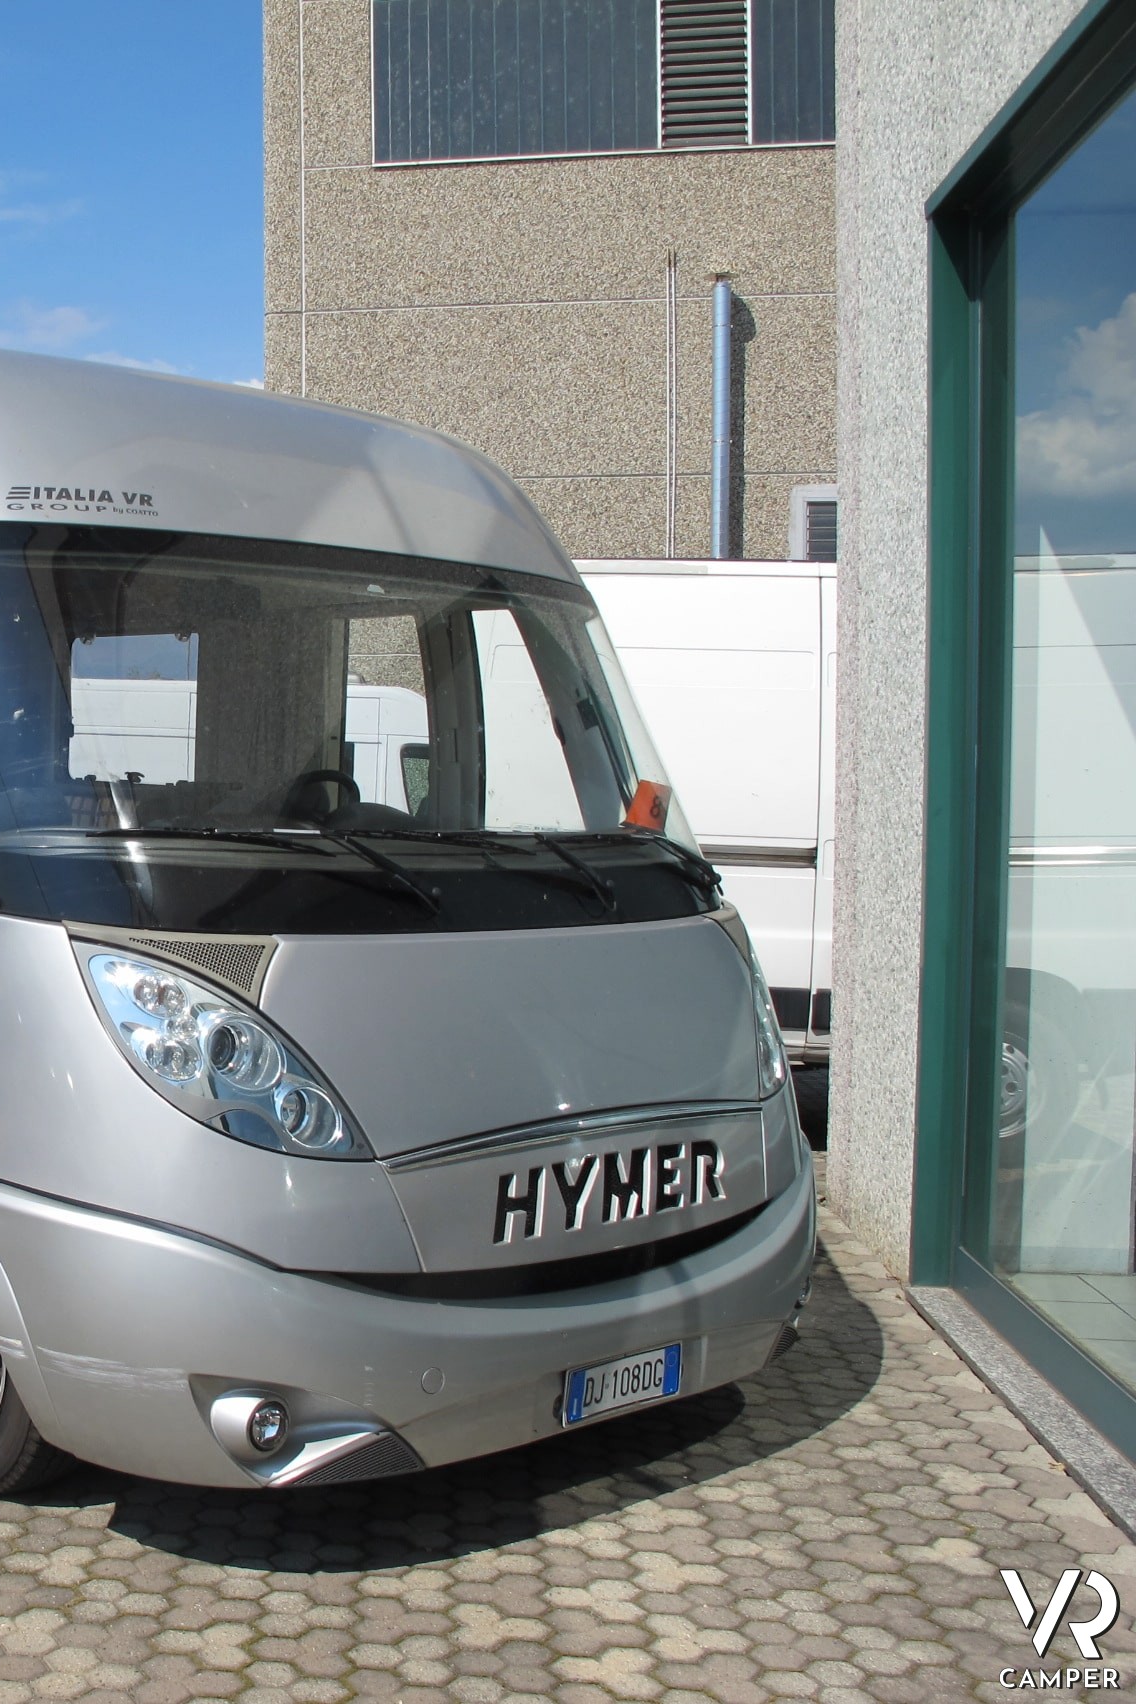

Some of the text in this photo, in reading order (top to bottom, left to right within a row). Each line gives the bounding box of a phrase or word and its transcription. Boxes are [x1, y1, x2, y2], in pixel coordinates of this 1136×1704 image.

[33, 486, 154, 507] ITALIA VR
[6, 503, 107, 513] GROUP
[493, 1141, 726, 1244] HYMER
